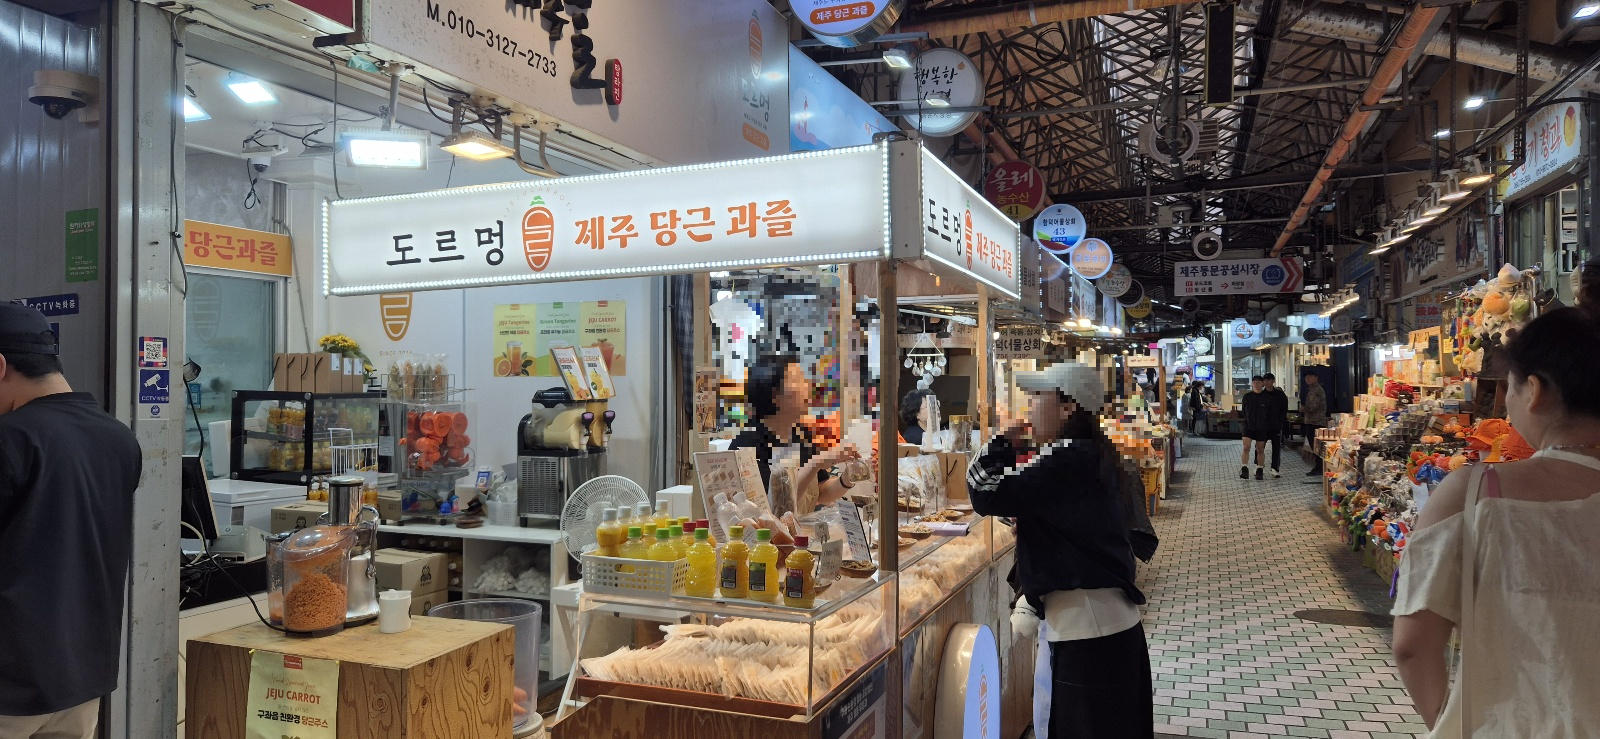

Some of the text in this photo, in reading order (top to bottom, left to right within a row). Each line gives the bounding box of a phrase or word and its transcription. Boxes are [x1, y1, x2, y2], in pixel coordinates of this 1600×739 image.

[816, 9, 832, 20] 제주
[834, 7, 849, 18] 당근
[426, 0, 557, 77] M.010-3127-2733
[989, 167, 1035, 193] 올레
[997, 193, 1031, 204] 농수산
[1007, 205, 1019, 215] 41
[575, 199, 797, 250] 제주 당근 과즐
[1053, 227, 1066, 235] 43
[387, 220, 504, 267] 도르멍
[927, 198, 962, 256] 도르멍
[976, 232, 989, 264] 제주
[990, 240, 1002, 272] 당근
[184, 230, 278, 267] 당근과즐
[1180, 263, 1260, 277] 제주동문공설시장
[265, 687, 321, 704] JEJU CARROT
[257, 709, 329, 728] 구좌읍 친환경 당근주스
